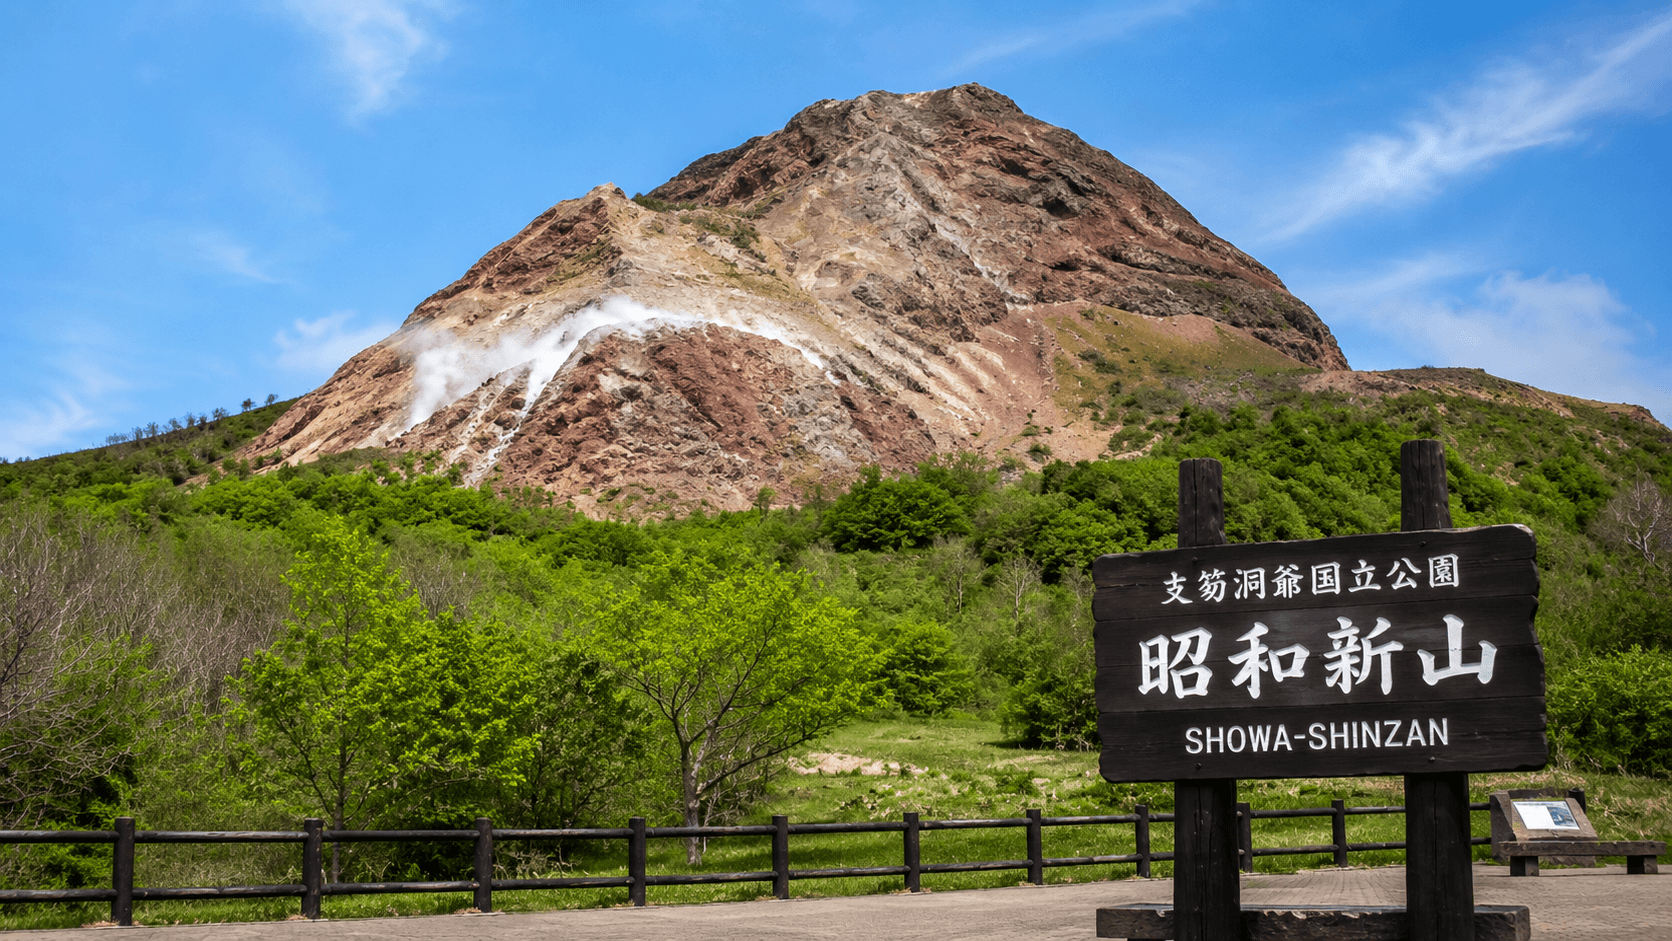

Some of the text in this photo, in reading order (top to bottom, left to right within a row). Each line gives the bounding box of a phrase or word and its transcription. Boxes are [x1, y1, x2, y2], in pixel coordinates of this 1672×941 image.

[1161, 554, 1460, 605] 支笏洞爺国立公園
[1138, 615, 1498, 700] 昭和新山
[1185, 717, 1449, 755] SHOWA-SHINZAN
